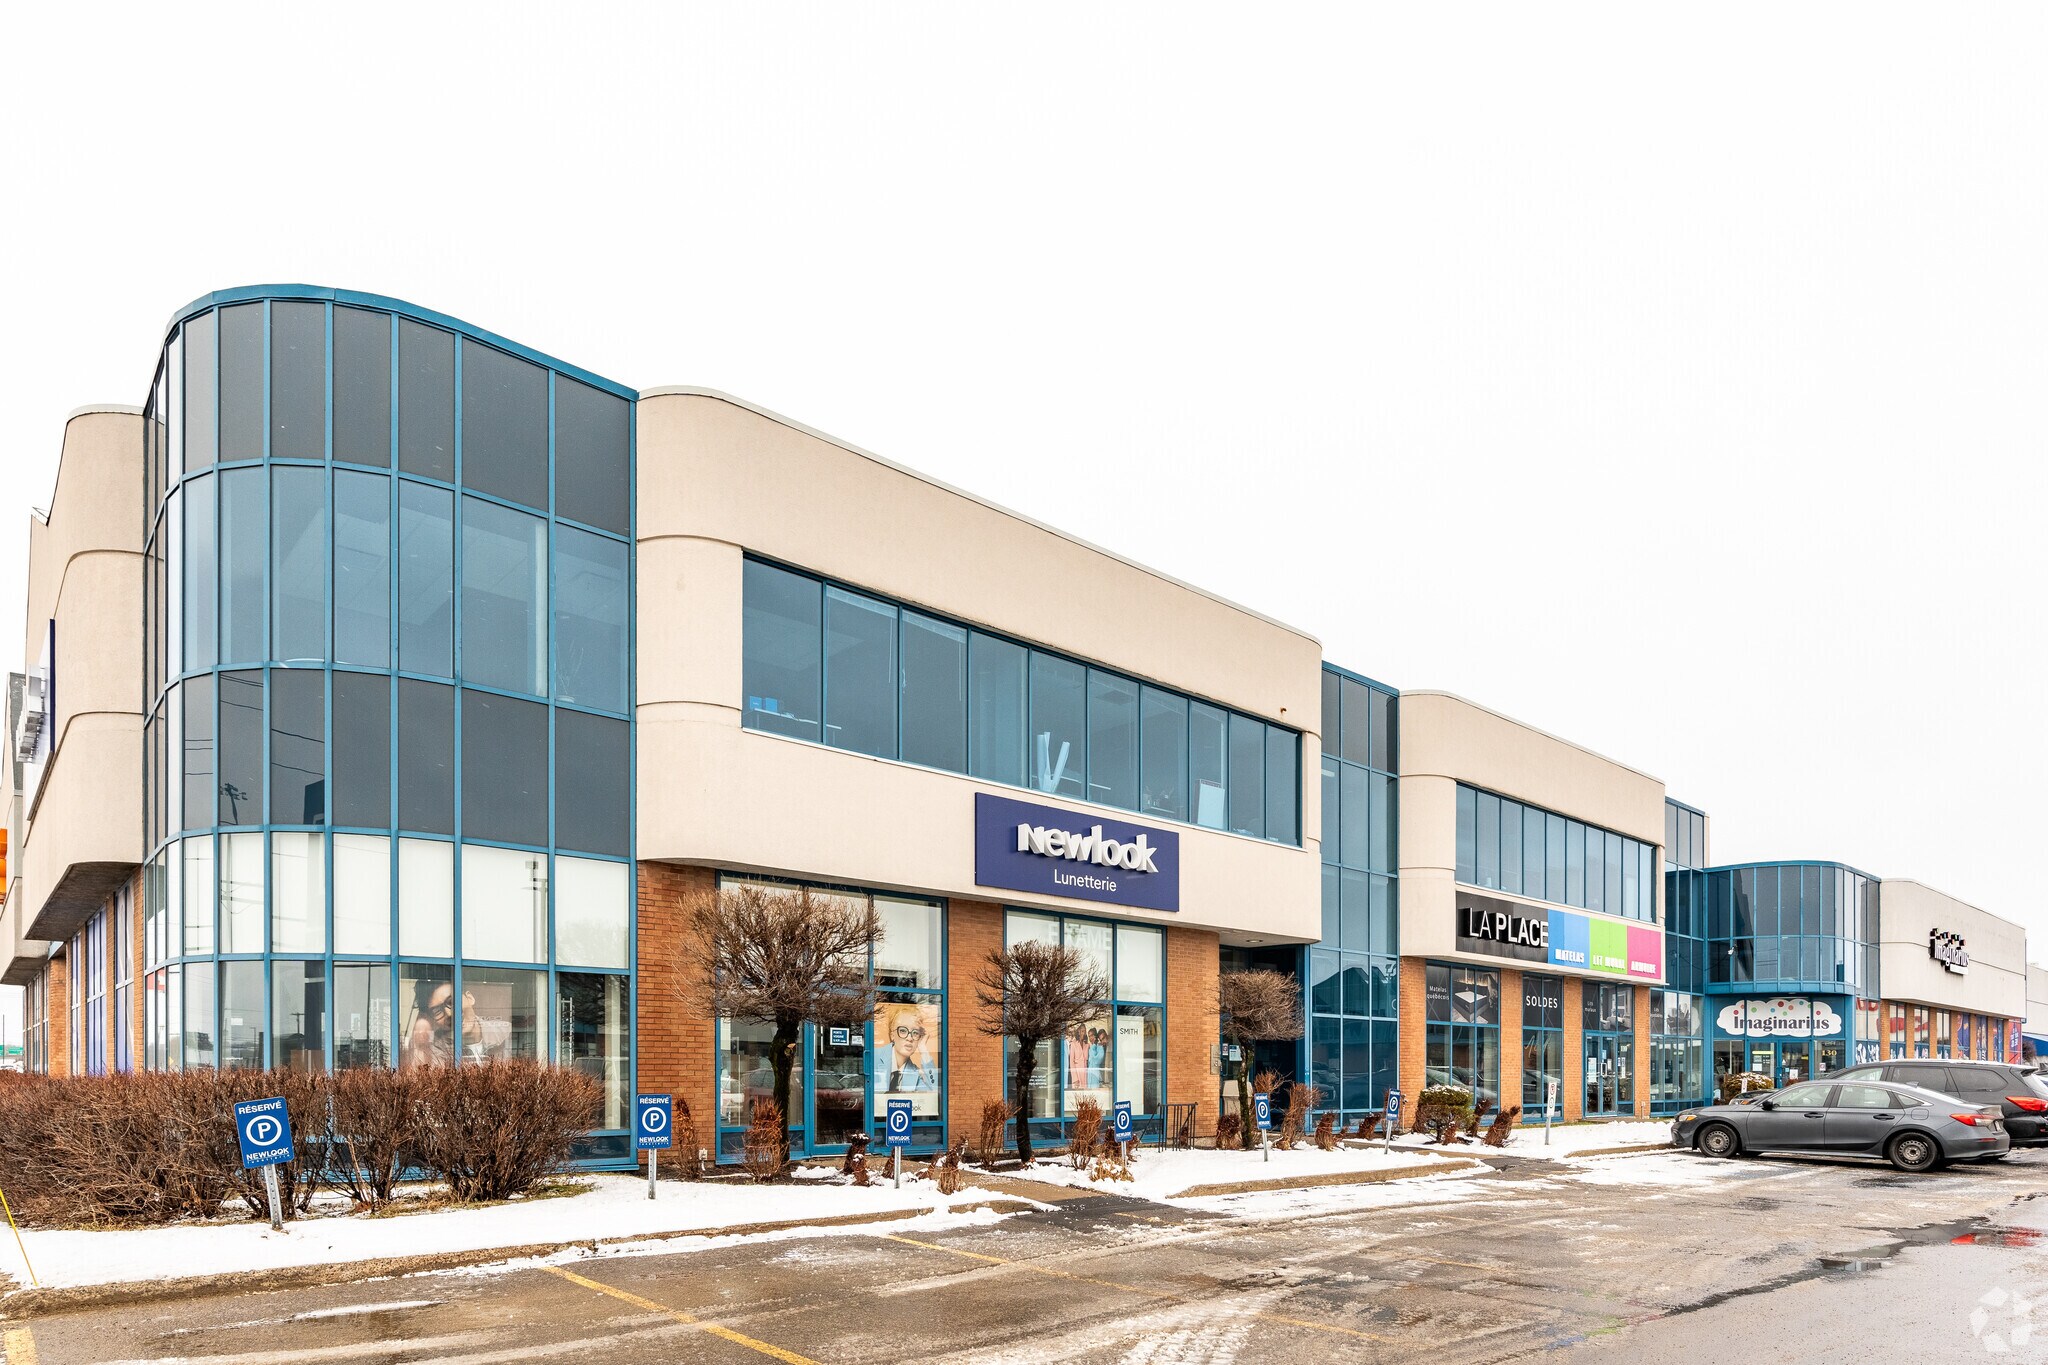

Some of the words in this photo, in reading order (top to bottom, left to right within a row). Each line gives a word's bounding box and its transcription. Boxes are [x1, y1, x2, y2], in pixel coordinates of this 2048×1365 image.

[1054, 868, 1117, 892] Lunetterie
[1469, 907, 1492, 940] LA
[1495, 912, 1549, 948] PLACE
[1555, 948, 1585, 964] MATELAS
[1525, 994, 1558, 1009] SOLDES
[1733, 1015, 1830, 1032] Imaginarius
[1119, 1027, 1139, 1036] SMITH
[238, 1101, 282, 1114] RÉSERVÉ
[888, 1101, 911, 1109] RÉSERVÉ
[246, 1147, 289, 1160] NEWLOOK
